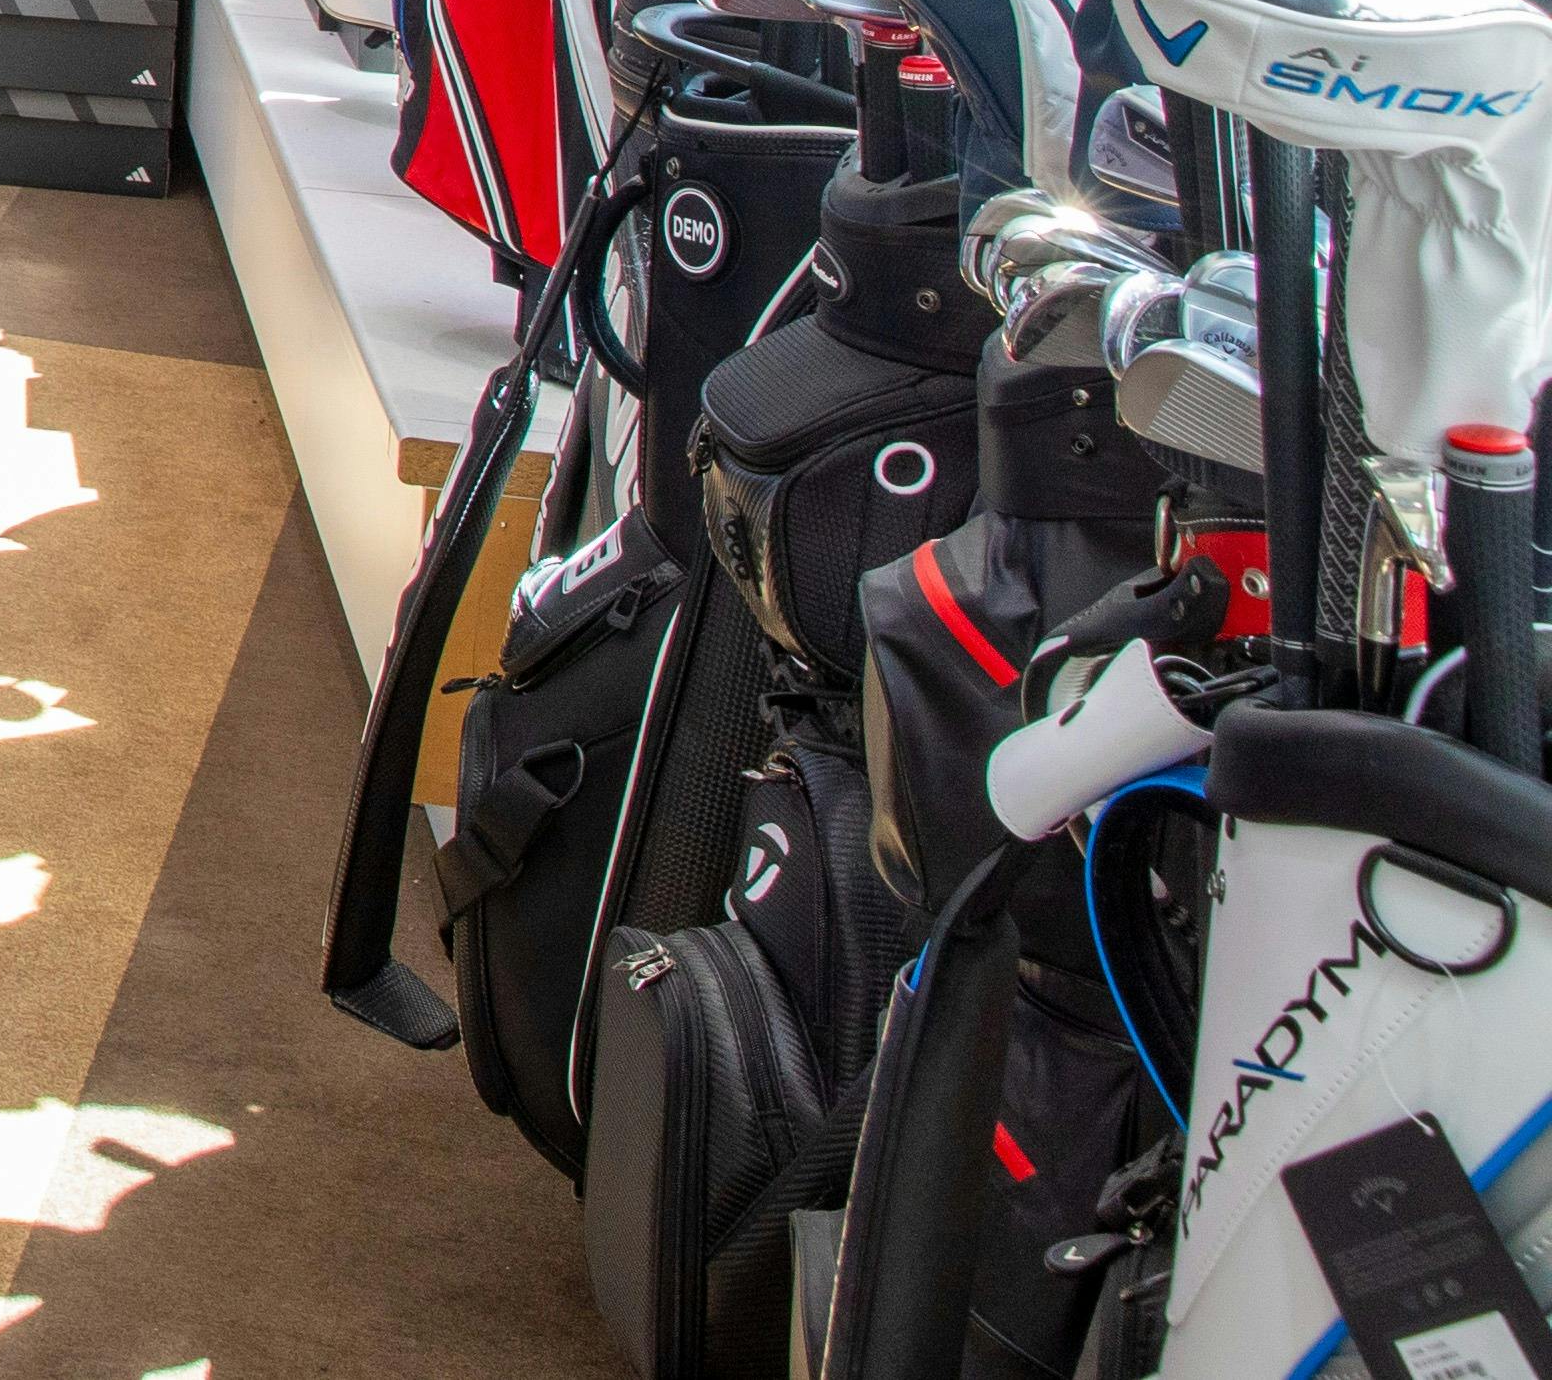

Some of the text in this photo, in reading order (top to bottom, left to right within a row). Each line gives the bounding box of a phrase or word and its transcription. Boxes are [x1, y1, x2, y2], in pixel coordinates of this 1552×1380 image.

[1288, 46, 1367, 73] Ai
[671, 216, 716, 247] DEMO
[1203, 331, 1255, 358] Callaway
